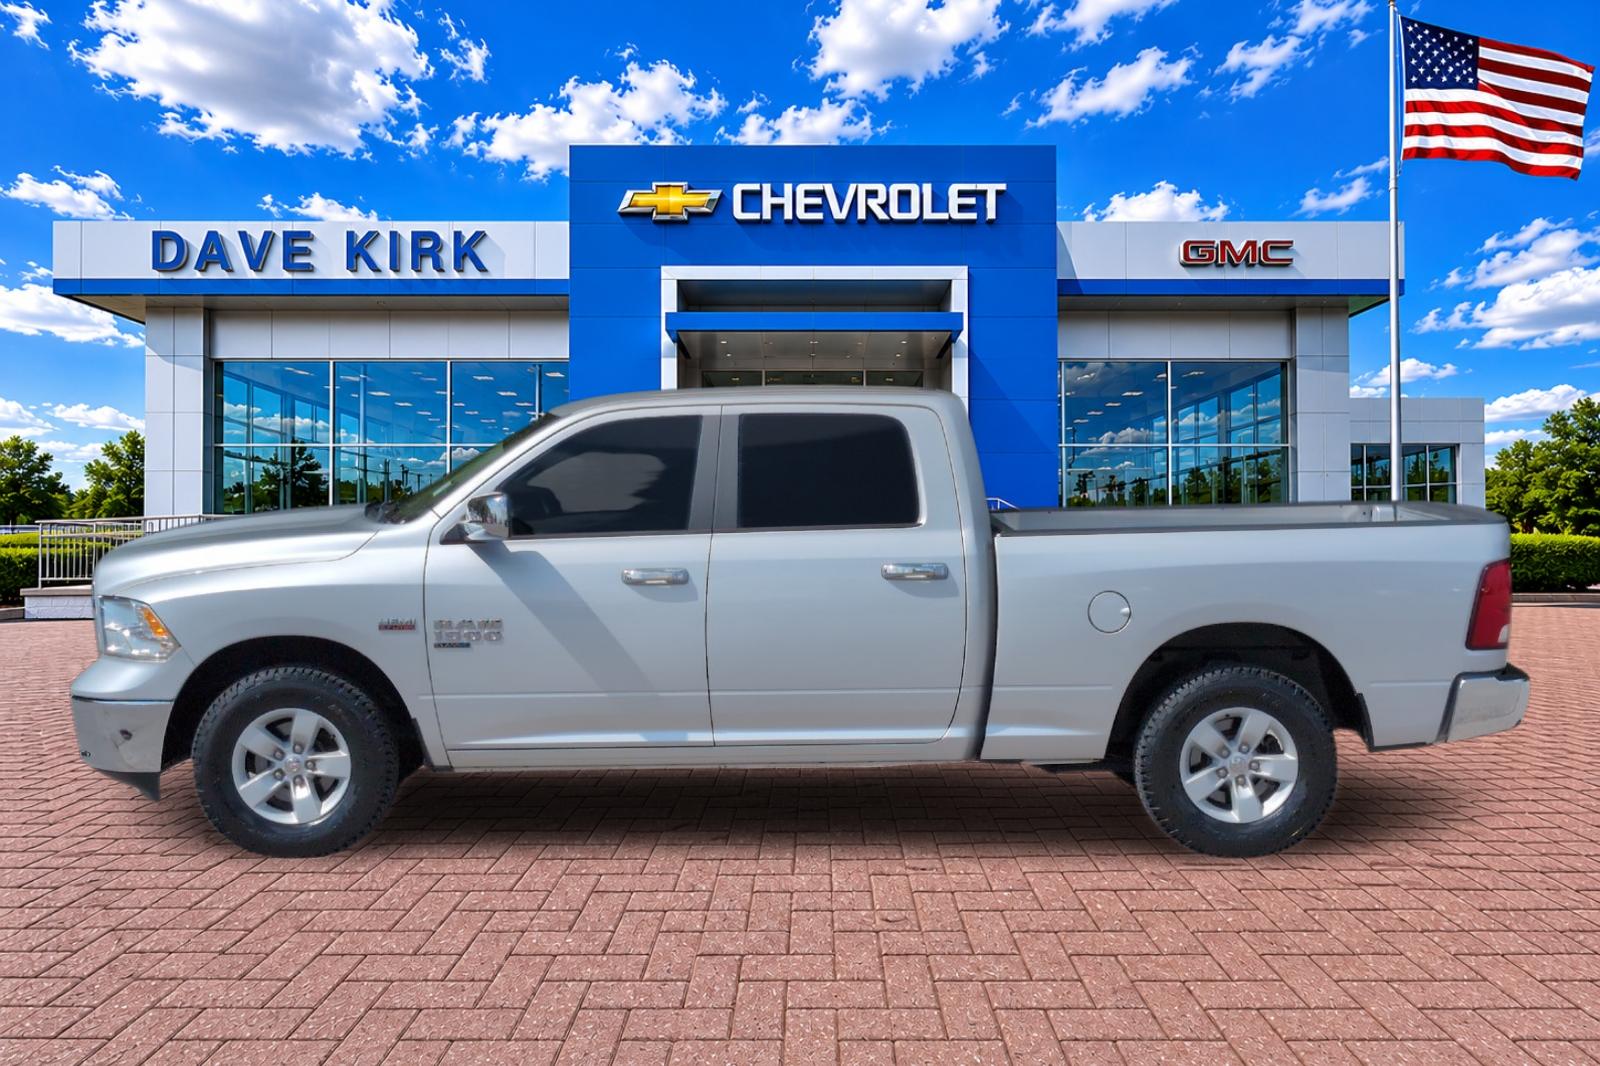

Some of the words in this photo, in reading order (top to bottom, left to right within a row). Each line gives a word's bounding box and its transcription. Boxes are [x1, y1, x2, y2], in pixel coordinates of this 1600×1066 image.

[732, 183, 1006, 221] CHEVROLET
[152, 230, 315, 273] DAVE
[346, 230, 489, 273] KIRK
[1180, 239, 1294, 267] GMC
